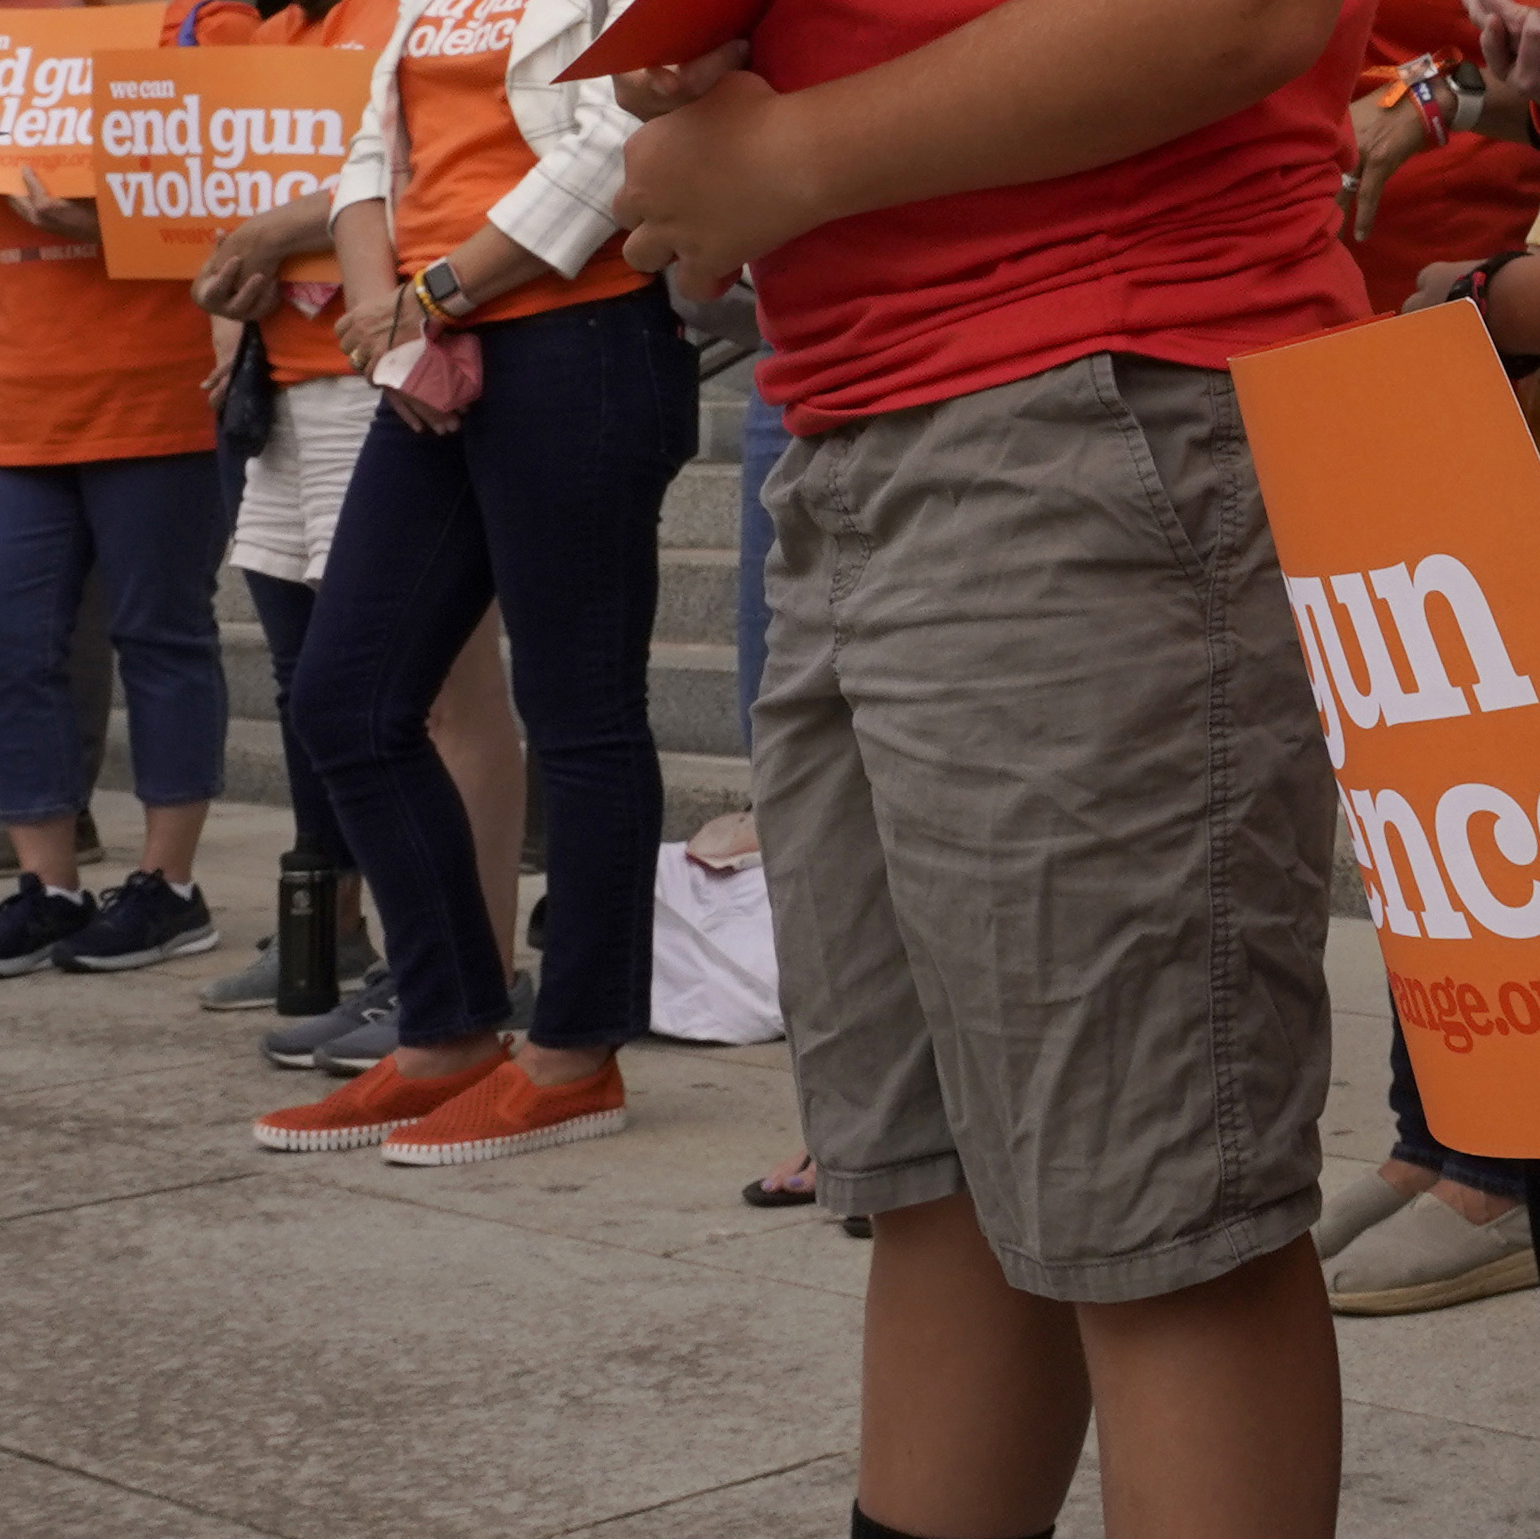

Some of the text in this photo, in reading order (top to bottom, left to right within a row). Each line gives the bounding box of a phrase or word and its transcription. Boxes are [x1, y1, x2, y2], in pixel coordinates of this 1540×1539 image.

[109, 79, 176, 100] we can
[101, 93, 346, 170] end gun
